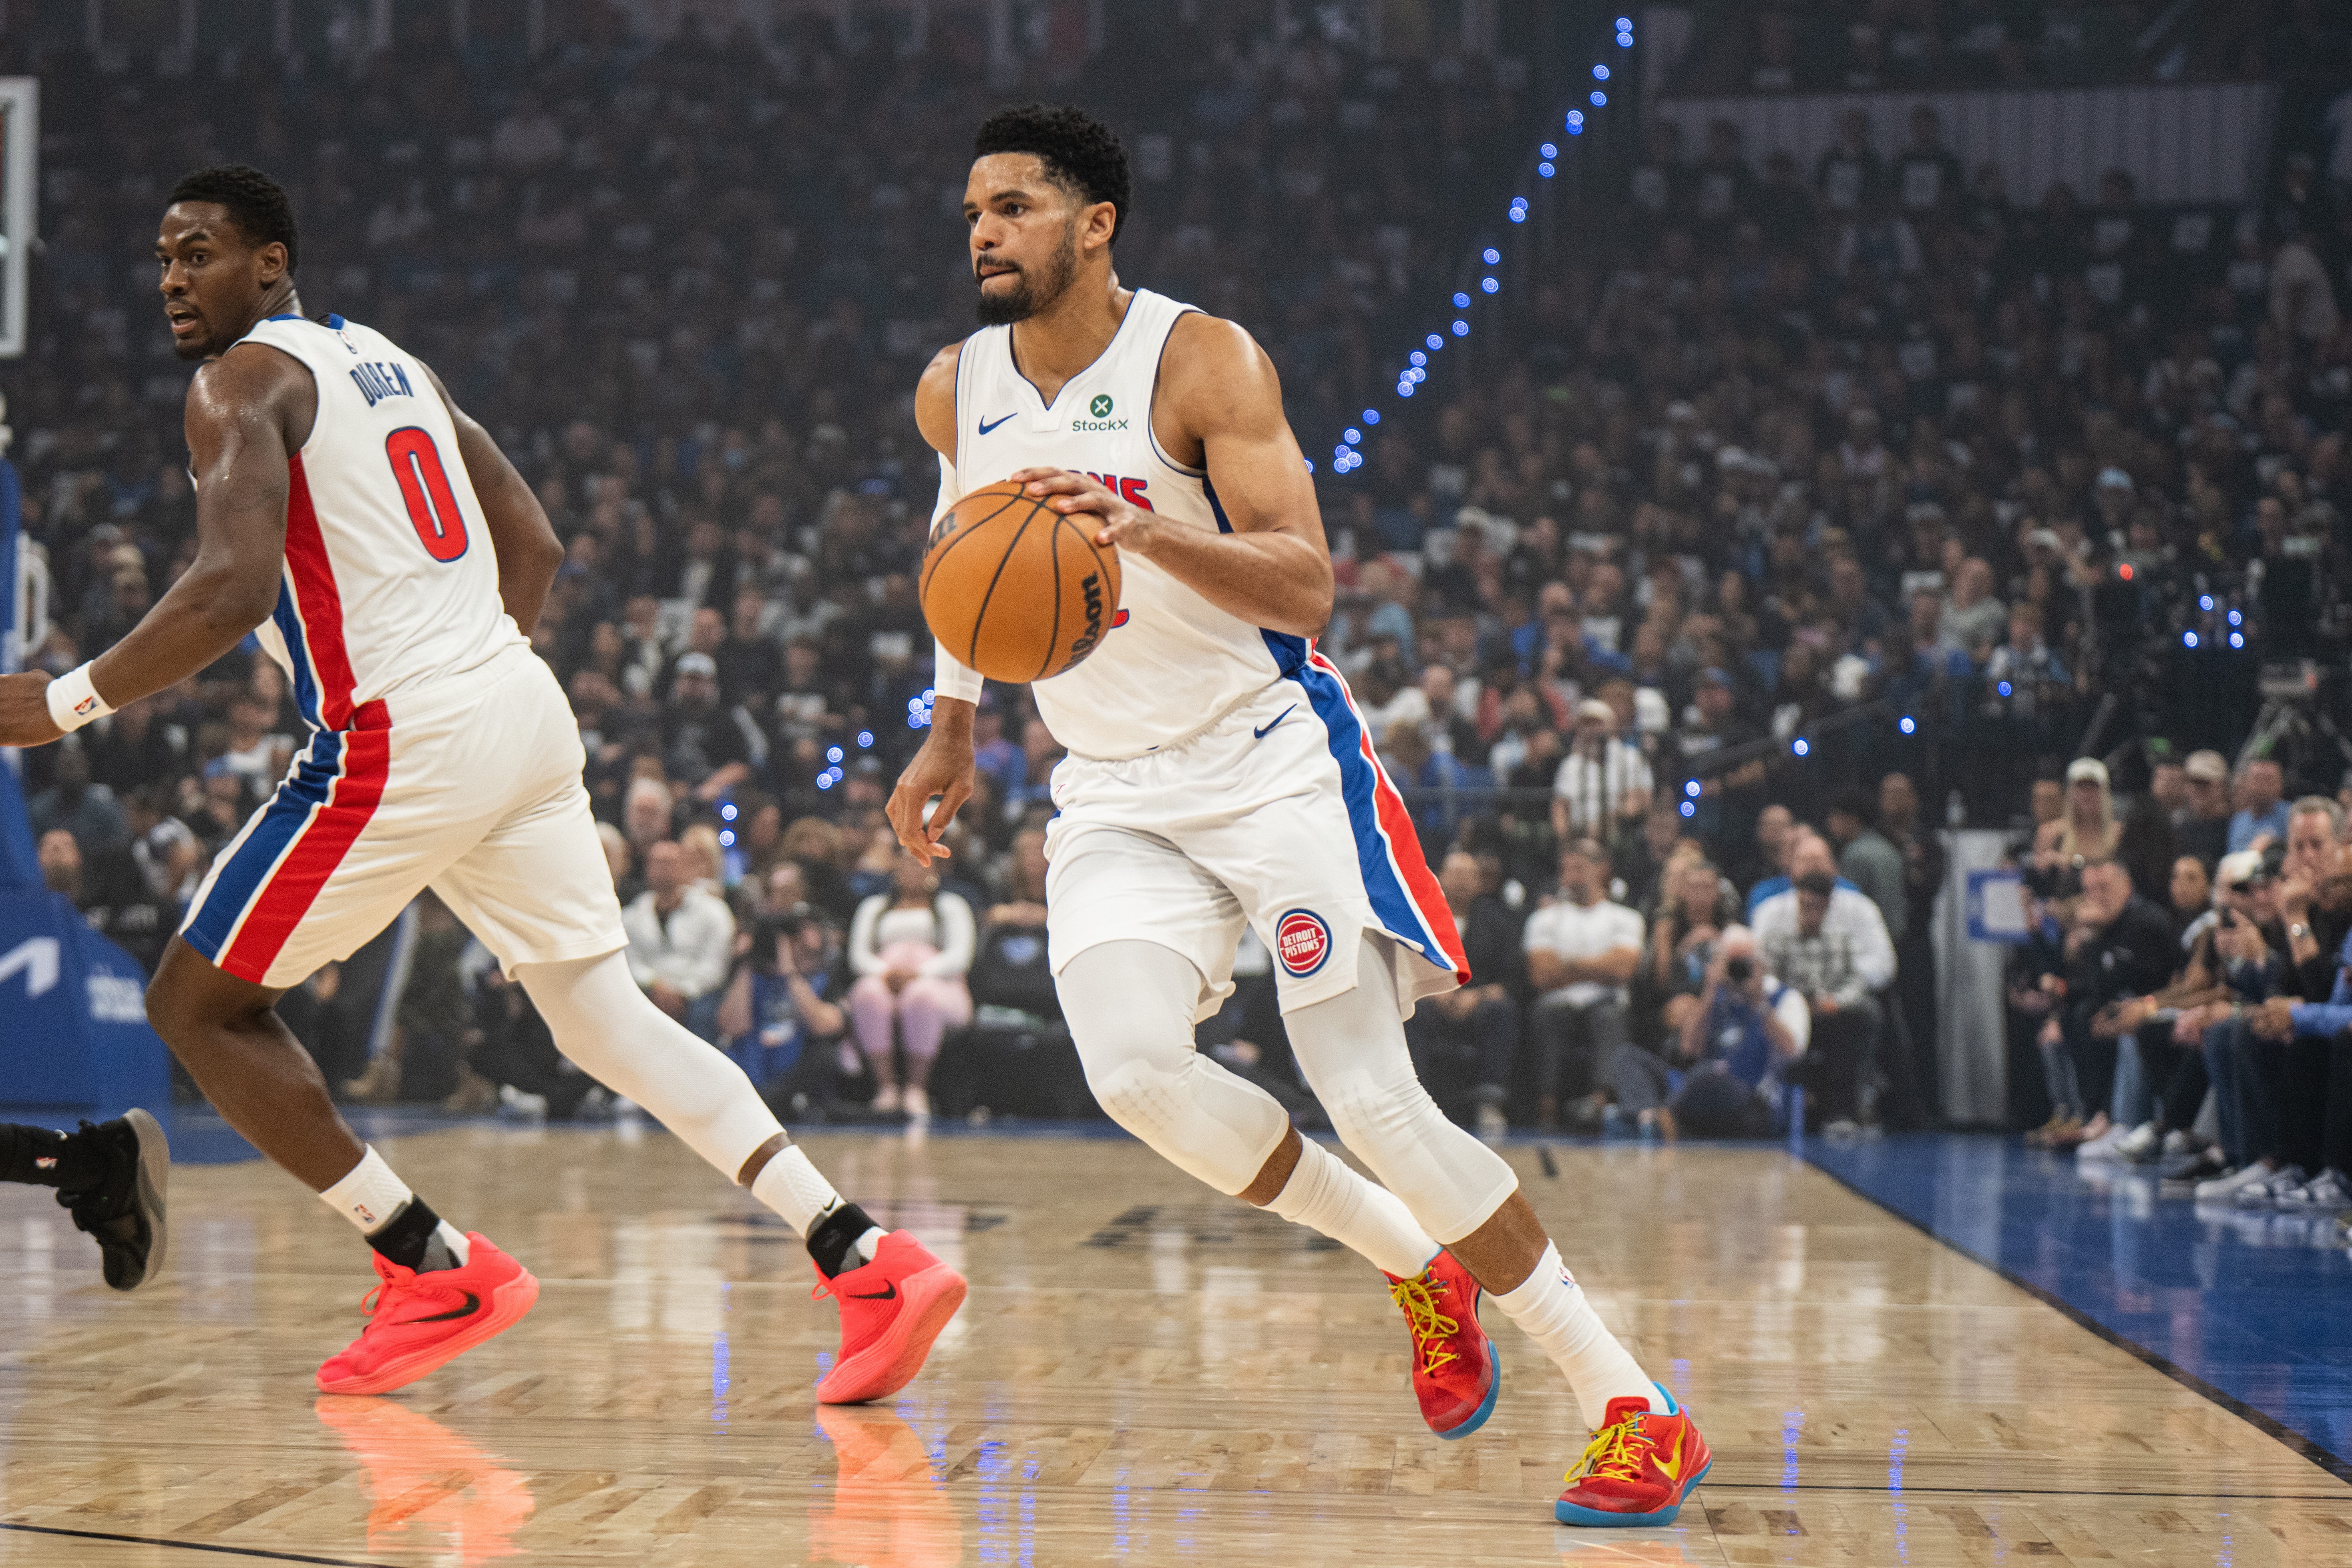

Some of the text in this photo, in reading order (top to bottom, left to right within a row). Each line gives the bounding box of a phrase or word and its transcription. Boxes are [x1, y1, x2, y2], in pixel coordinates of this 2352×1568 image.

[350, 362, 415, 408] DUREN
[1072, 419, 1128, 431] StockX
[385, 426, 469, 563] 0
[1056, 569, 1102, 677] ilson
[1282, 927, 1316, 947] DETROIT
[1284, 938, 1320, 958] PISTONS
